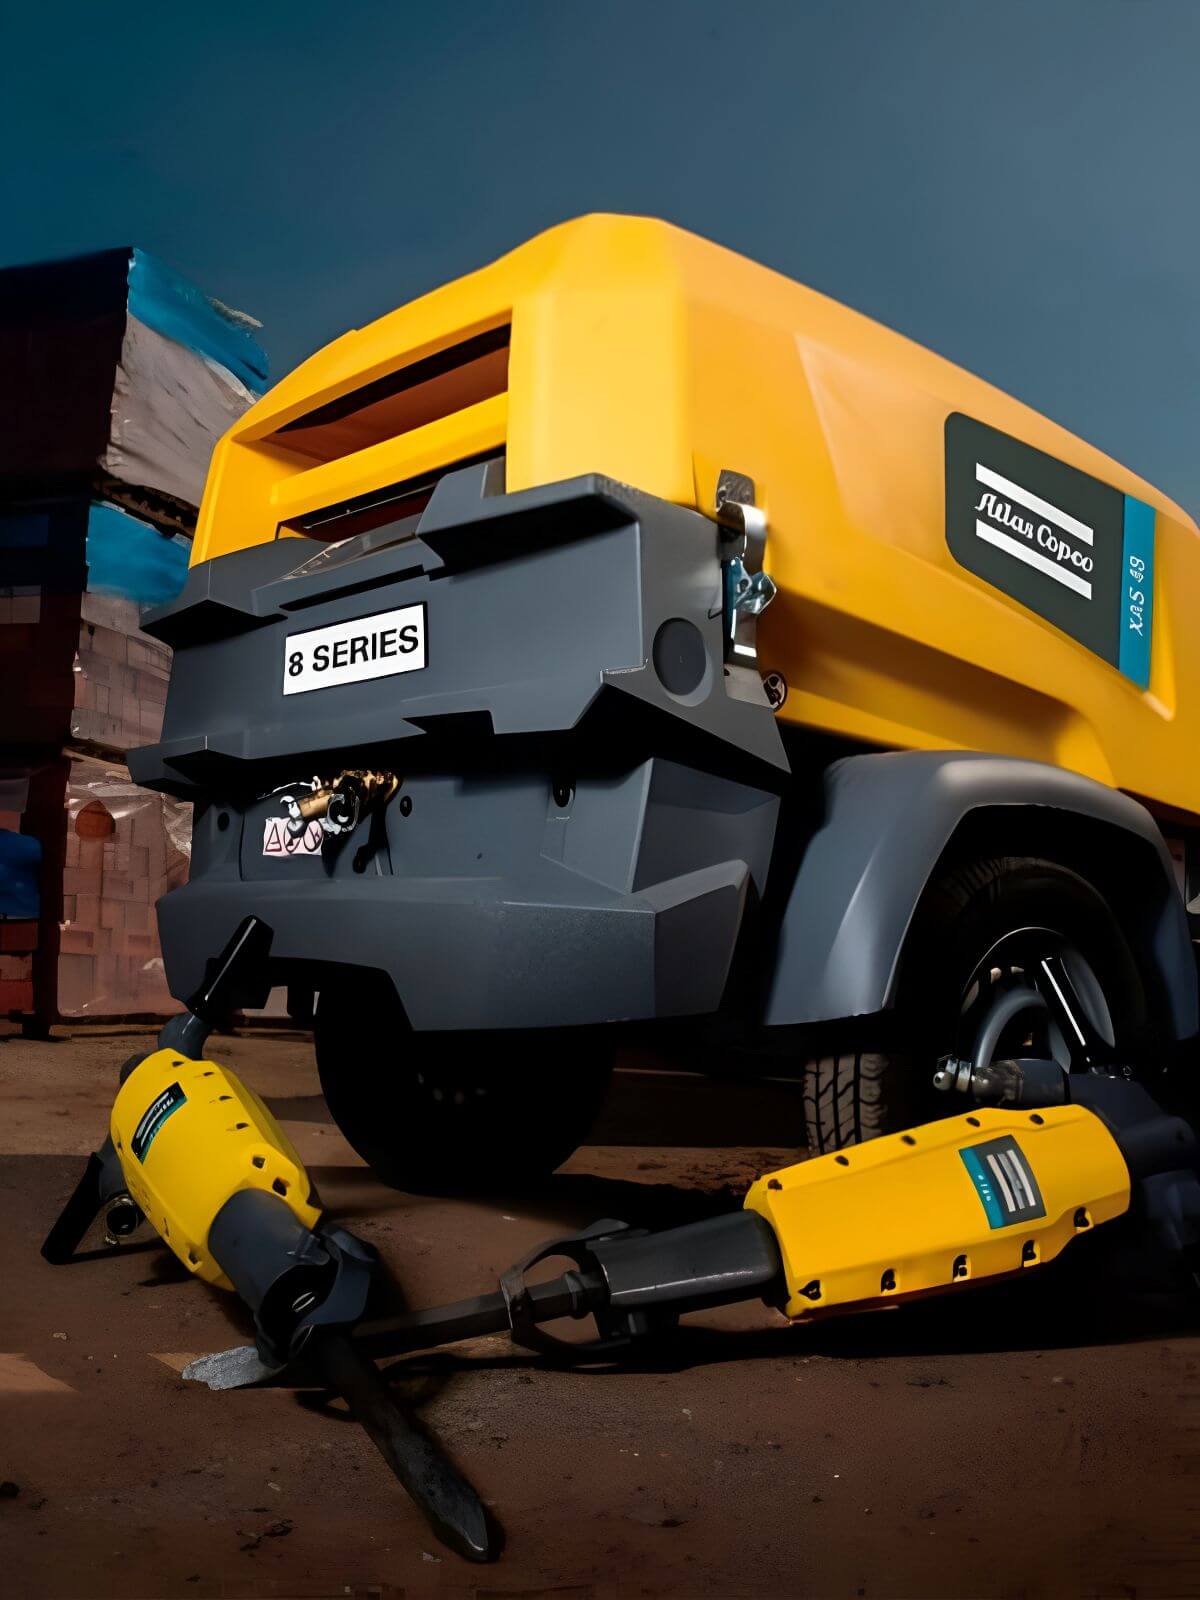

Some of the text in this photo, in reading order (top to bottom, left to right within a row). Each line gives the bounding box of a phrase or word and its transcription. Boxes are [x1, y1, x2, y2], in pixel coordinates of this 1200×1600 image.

[974, 493, 1094, 572] Atlas Copco
[288, 625, 419, 677] 8 SERIES
